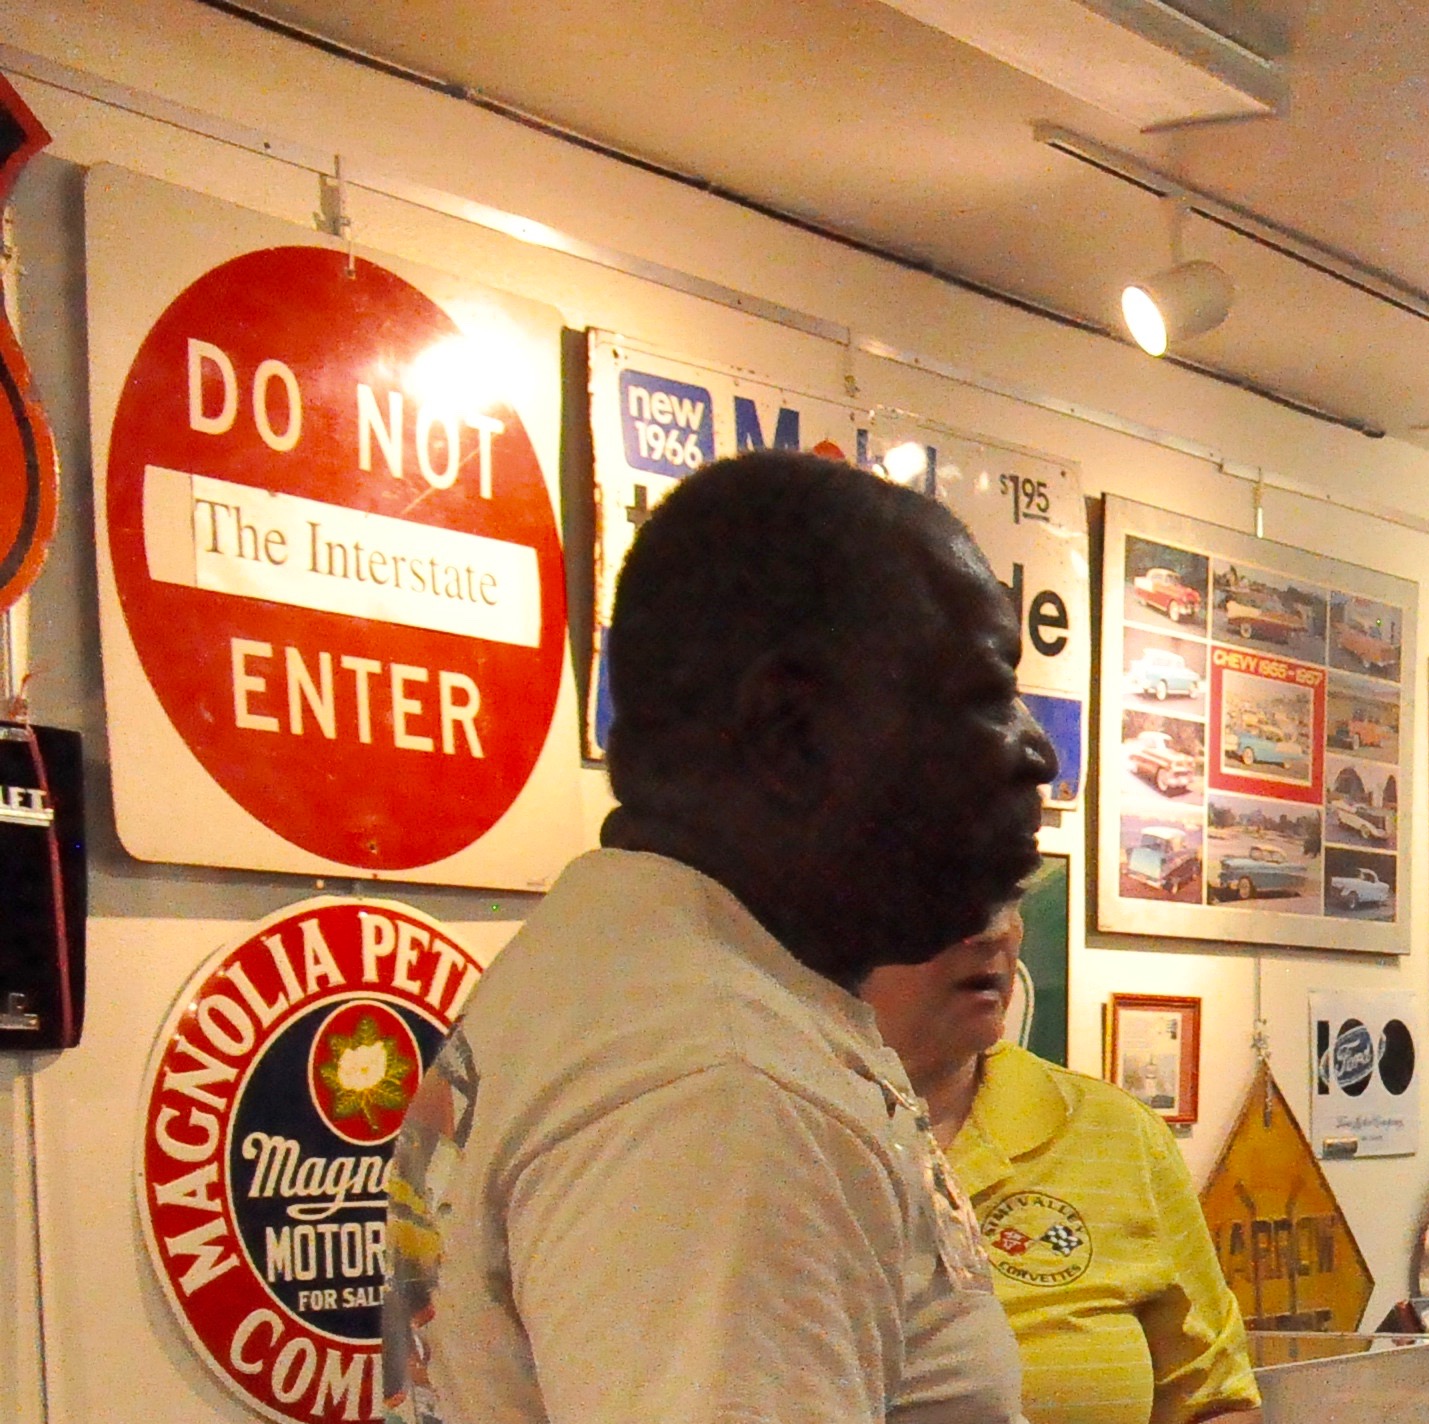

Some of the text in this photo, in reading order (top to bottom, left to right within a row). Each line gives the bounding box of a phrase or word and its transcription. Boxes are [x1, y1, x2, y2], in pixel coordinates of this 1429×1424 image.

[187, 336, 504, 500] DO NOT
[627, 384, 704, 431] new
[634, 420, 703, 469] 1966
[193, 497, 499, 607] The Interstate
[230, 636, 486, 759] ENTER
[156, 918, 347, 1298] MAGNOLIA
[984, 1196, 1084, 1237] SIMI VALLEY
[998, 1261, 1082, 1284] CORVETTES
[298, 1289, 338, 1312] FOR
